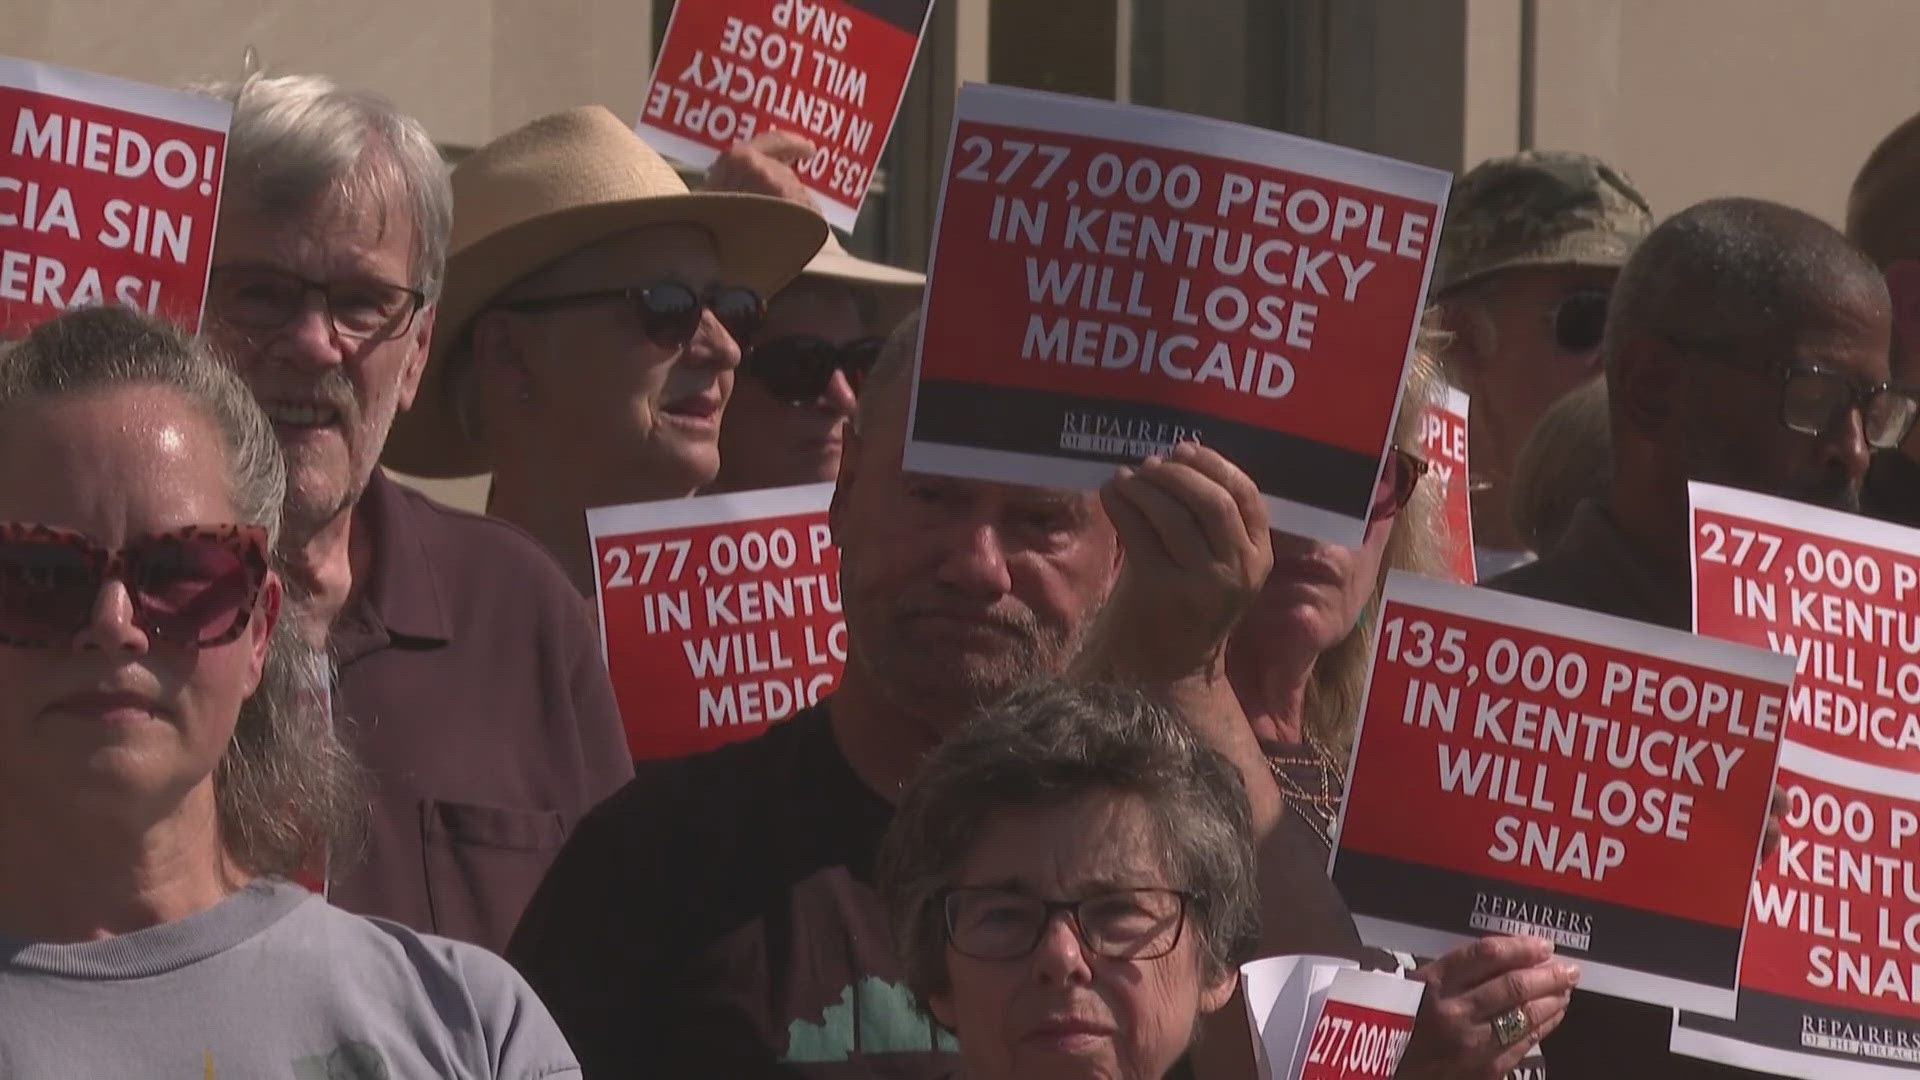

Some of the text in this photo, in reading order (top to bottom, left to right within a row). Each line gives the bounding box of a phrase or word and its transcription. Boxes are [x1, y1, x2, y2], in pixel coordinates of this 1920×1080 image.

[721, 16, 867, 108] WILL LOSE
[646, 82, 776, 143] EOPLE
[679, 51, 873, 156] IN KENTUCKY
[12, 107, 216, 197] MIEDO!
[98, 199, 192, 263] SIN
[957, 136, 1429, 261] 277,000 PEOPLE
[989, 196, 1376, 301] IN KENTUCKY
[1025, 257, 1318, 349] WILL LOSE
[1021, 315, 1295, 398] MEDICAID
[1063, 412, 1203, 446] REPAIRERS
[603, 528, 797, 589] 277,000
[1700, 522, 1881, 595] 277,000
[643, 590, 692, 635] IN
[1733, 575, 1777, 622] IN
[682, 628, 794, 680] WILL
[1385, 616, 1783, 743] 135,000 PEOPLE
[1402, 679, 1745, 792] IN KENTUCKY
[1437, 743, 1694, 841] WILL LOSE
[1488, 816, 1626, 883] SNAP
[1474, 893, 1593, 934] REPAIRERS
[1751, 879, 1861, 943] WILL
[1308, 1013, 1387, 1079] 277,000
